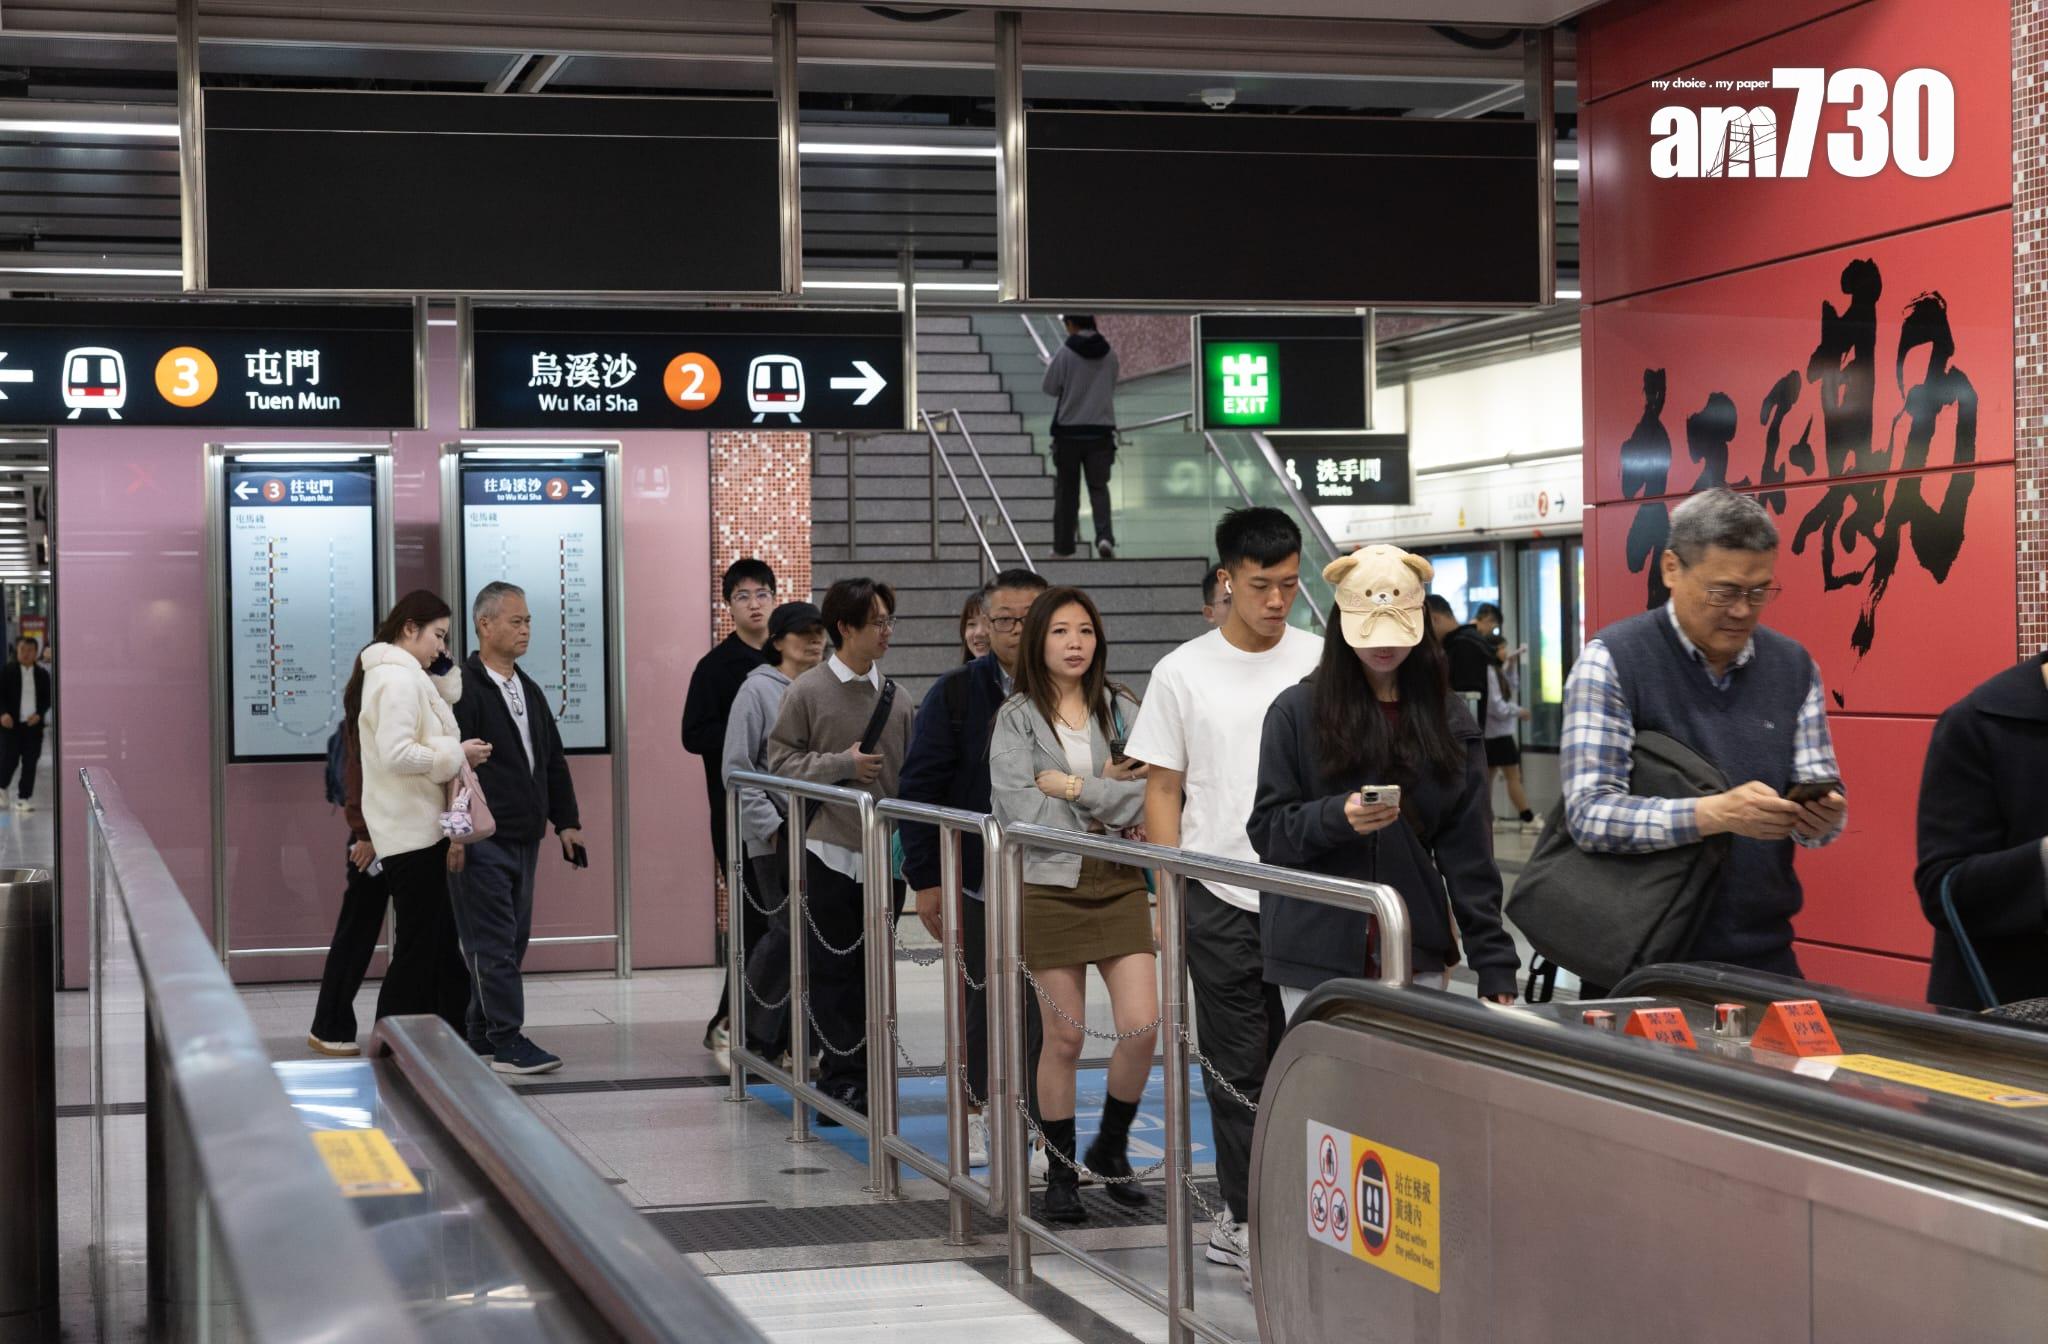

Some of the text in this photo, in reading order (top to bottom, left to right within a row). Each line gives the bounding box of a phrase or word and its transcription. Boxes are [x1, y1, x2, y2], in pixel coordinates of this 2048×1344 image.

[173, 357, 199, 397] 3
[245, 348, 321, 386] 屯門
[528, 351, 637, 389] 烏溪沙
[1222, 354, 1268, 397] 出
[680, 363, 705, 401] 2
[246, 391, 340, 410] Tuen Mun
[539, 393, 638, 412] Wu Kai Sha
[1223, 397, 1268, 414] EXIT
[1316, 458, 1382, 483] 洗手間
[269, 482, 280, 498] 3
[290, 479, 334, 494] 往屯門
[551, 481, 562, 497] 2
[1316, 484, 1354, 497] Toilets
[290, 494, 334, 502] to Tuen Mun
[1395, 1225, 1427, 1248] Stand within
[1395, 1243, 1435, 1270] the yellow lines
